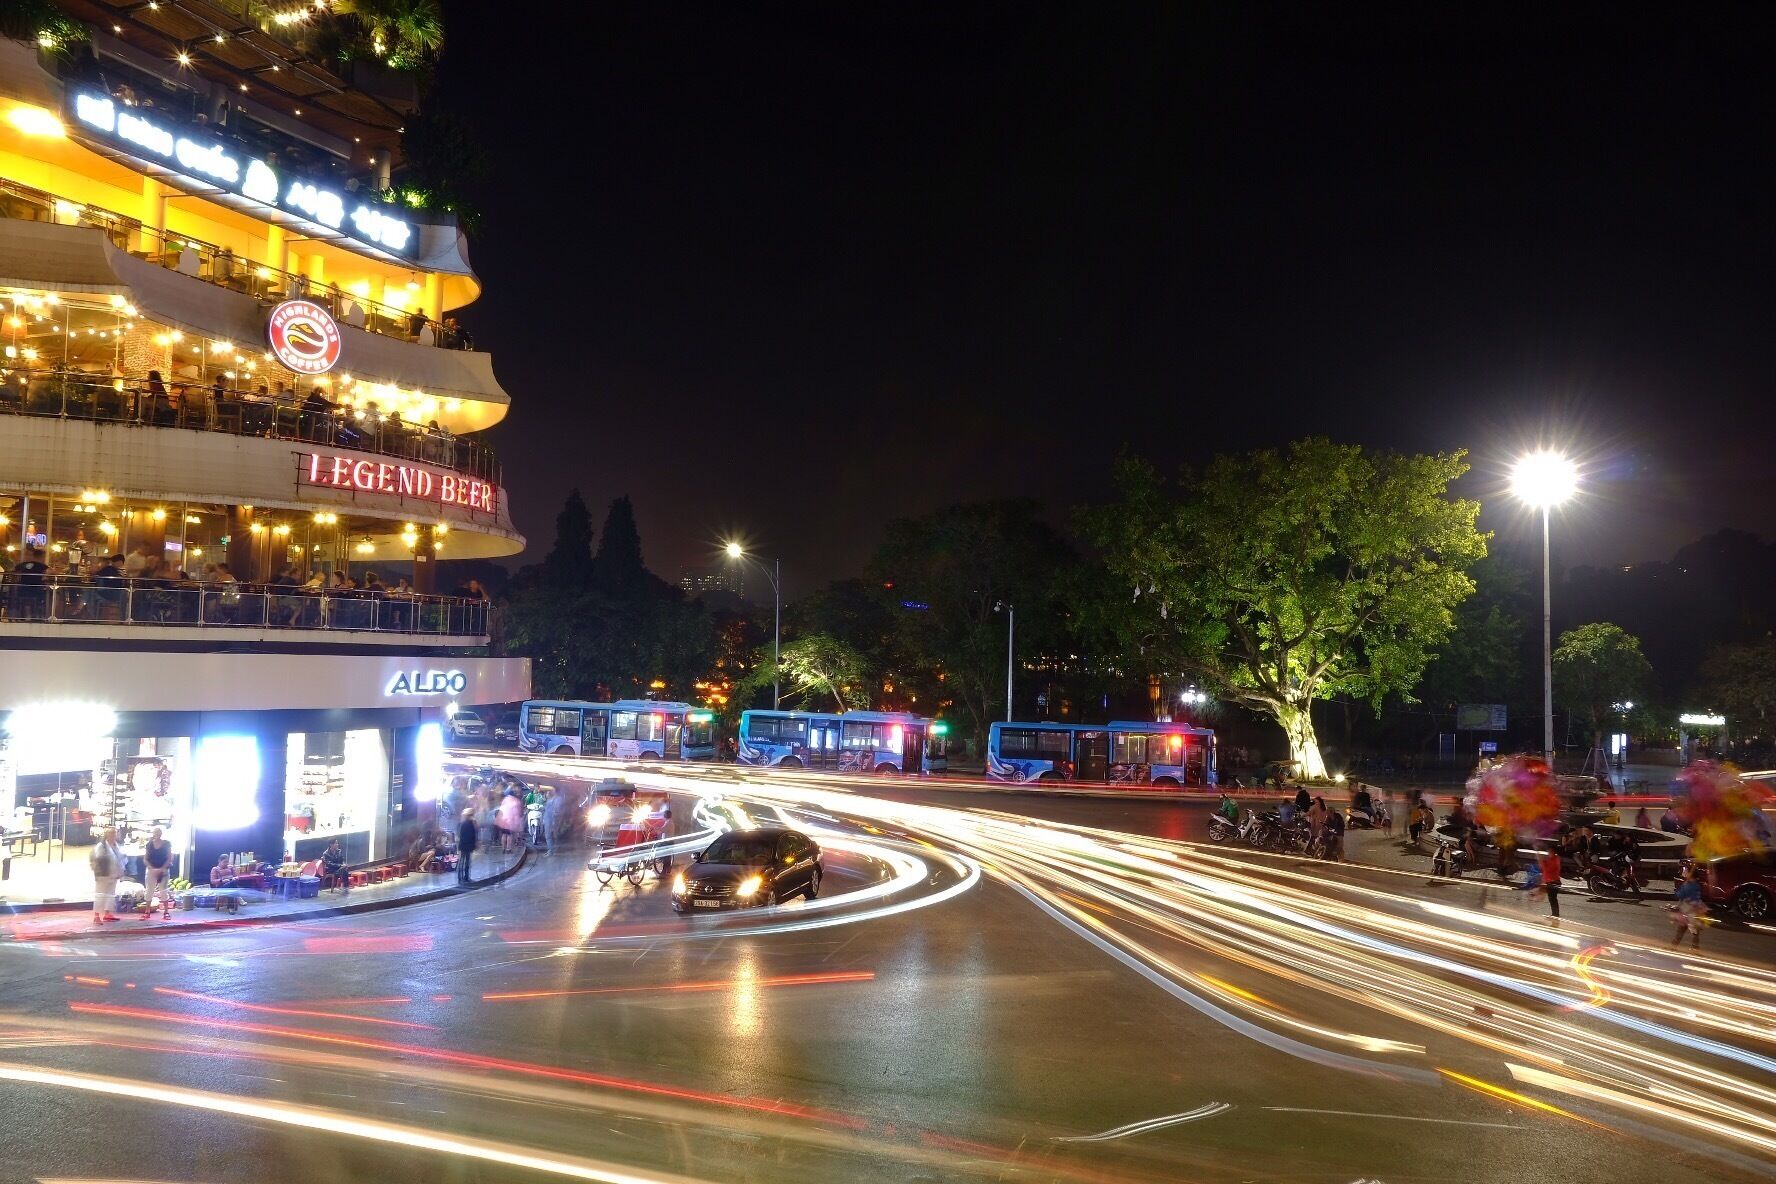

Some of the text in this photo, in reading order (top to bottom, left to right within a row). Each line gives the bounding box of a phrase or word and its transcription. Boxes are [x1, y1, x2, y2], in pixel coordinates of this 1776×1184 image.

[274, 305, 337, 342] HIGHLANDS
[281, 347, 328, 370] COFFEE
[310, 453, 491, 512] LEGEND BEER
[389, 670, 467, 694] ALDO
